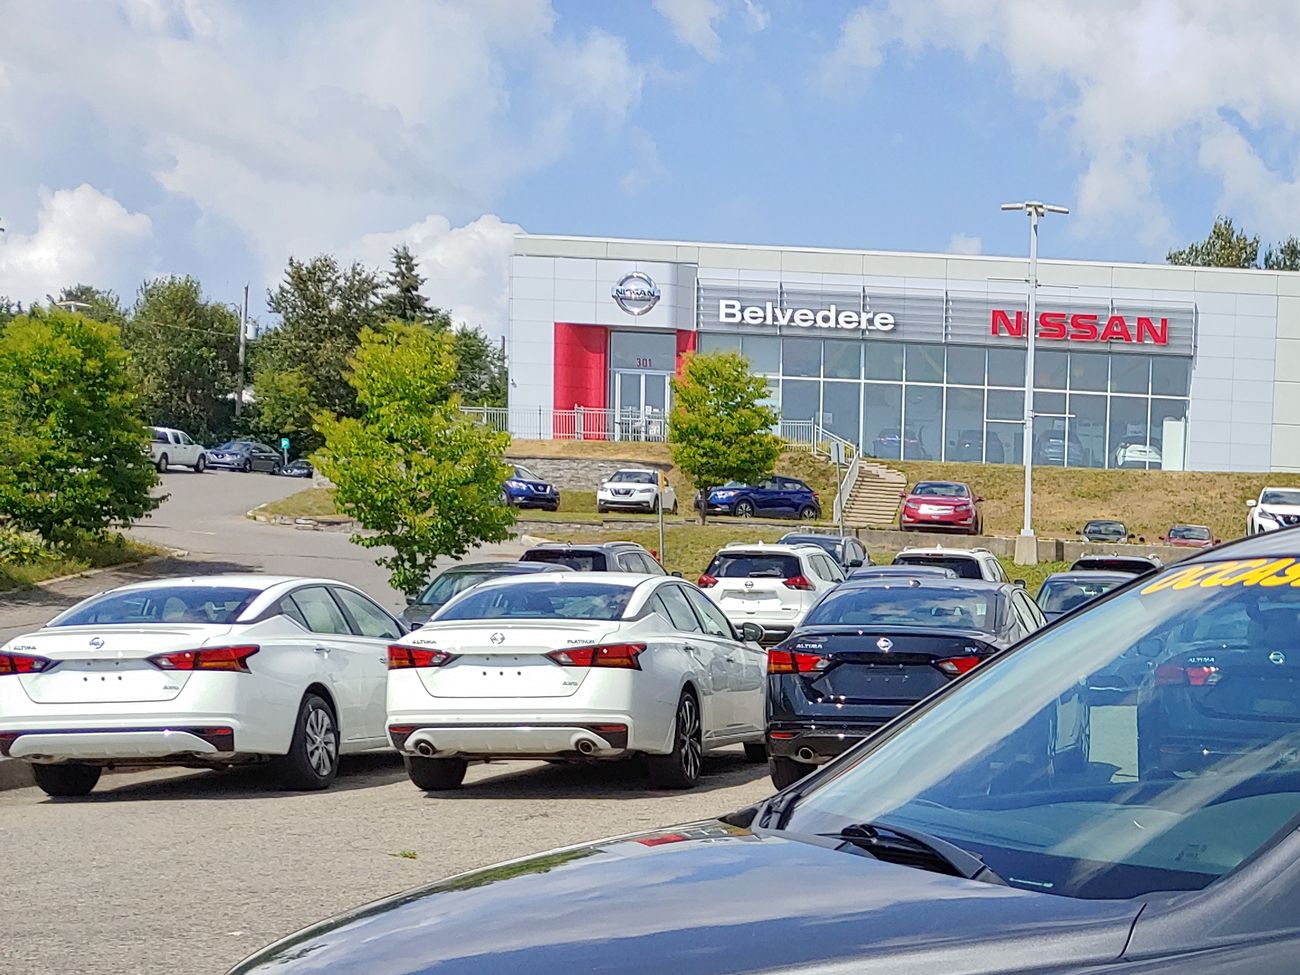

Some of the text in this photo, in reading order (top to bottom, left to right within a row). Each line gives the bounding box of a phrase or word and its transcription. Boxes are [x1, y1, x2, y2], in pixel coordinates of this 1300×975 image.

[719, 299, 896, 331] Belvedere
[991, 309, 1169, 346] NSSAN
[636, 357, 653, 368] 301
